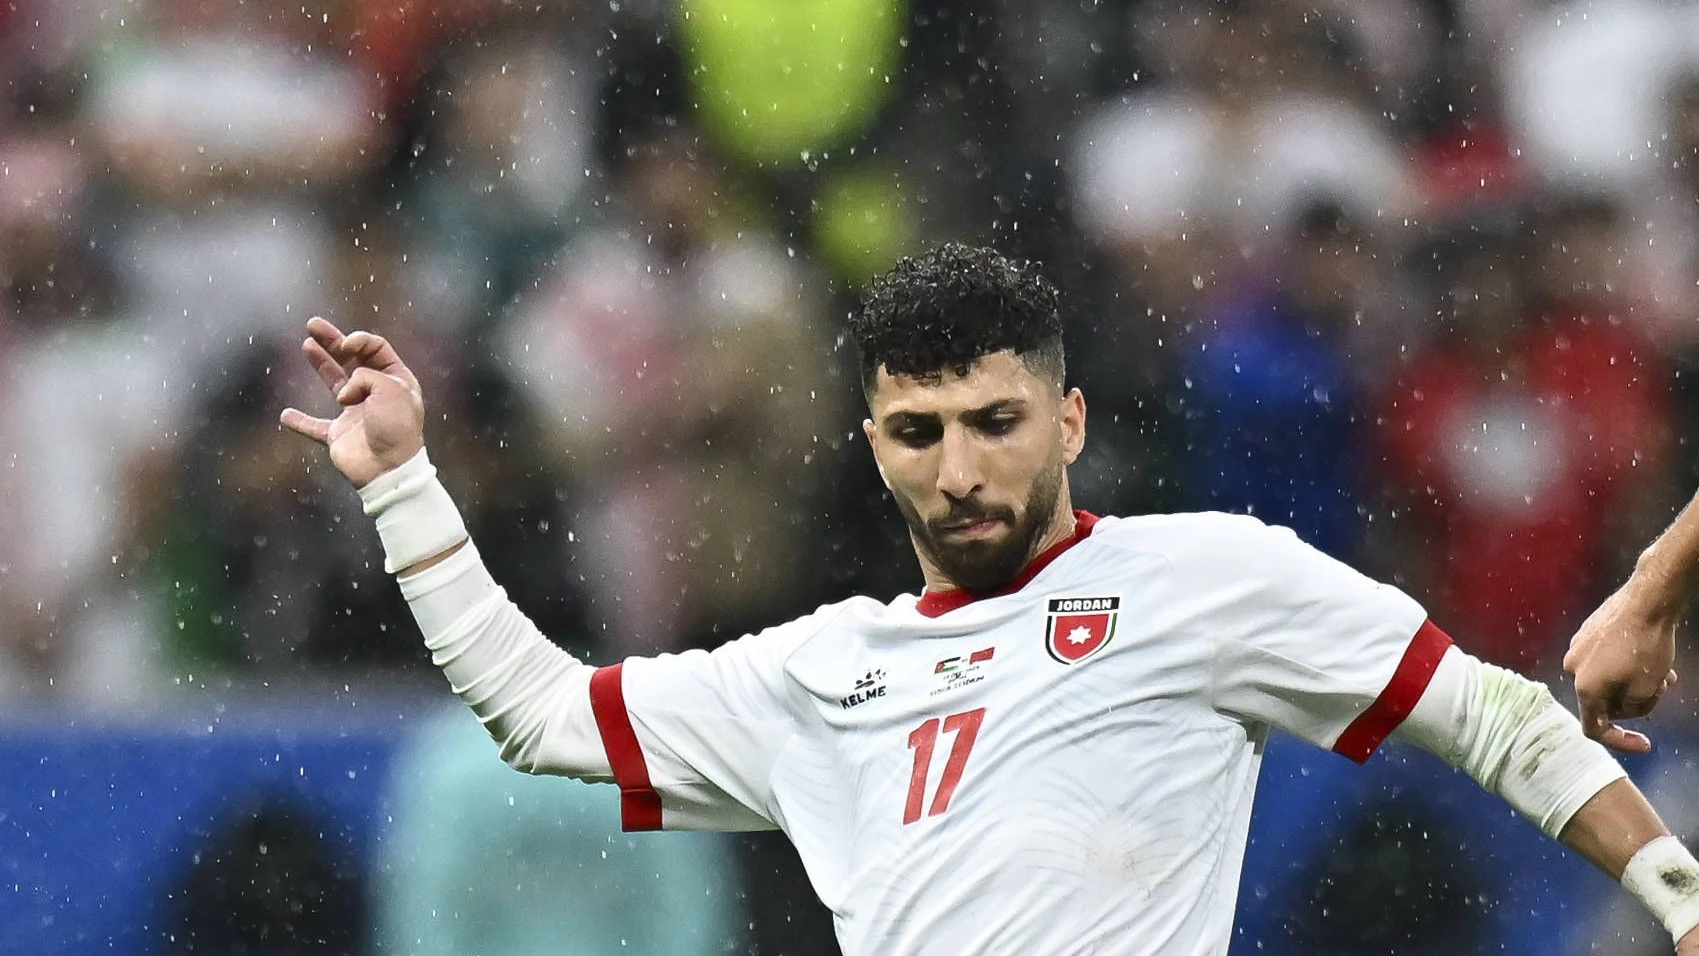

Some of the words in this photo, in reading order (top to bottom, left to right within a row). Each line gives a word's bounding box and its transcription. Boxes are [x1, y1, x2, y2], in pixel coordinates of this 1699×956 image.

[1055, 598, 1113, 613] JORDAN
[839, 685, 887, 711] KELME
[902, 706, 987, 826] 17
